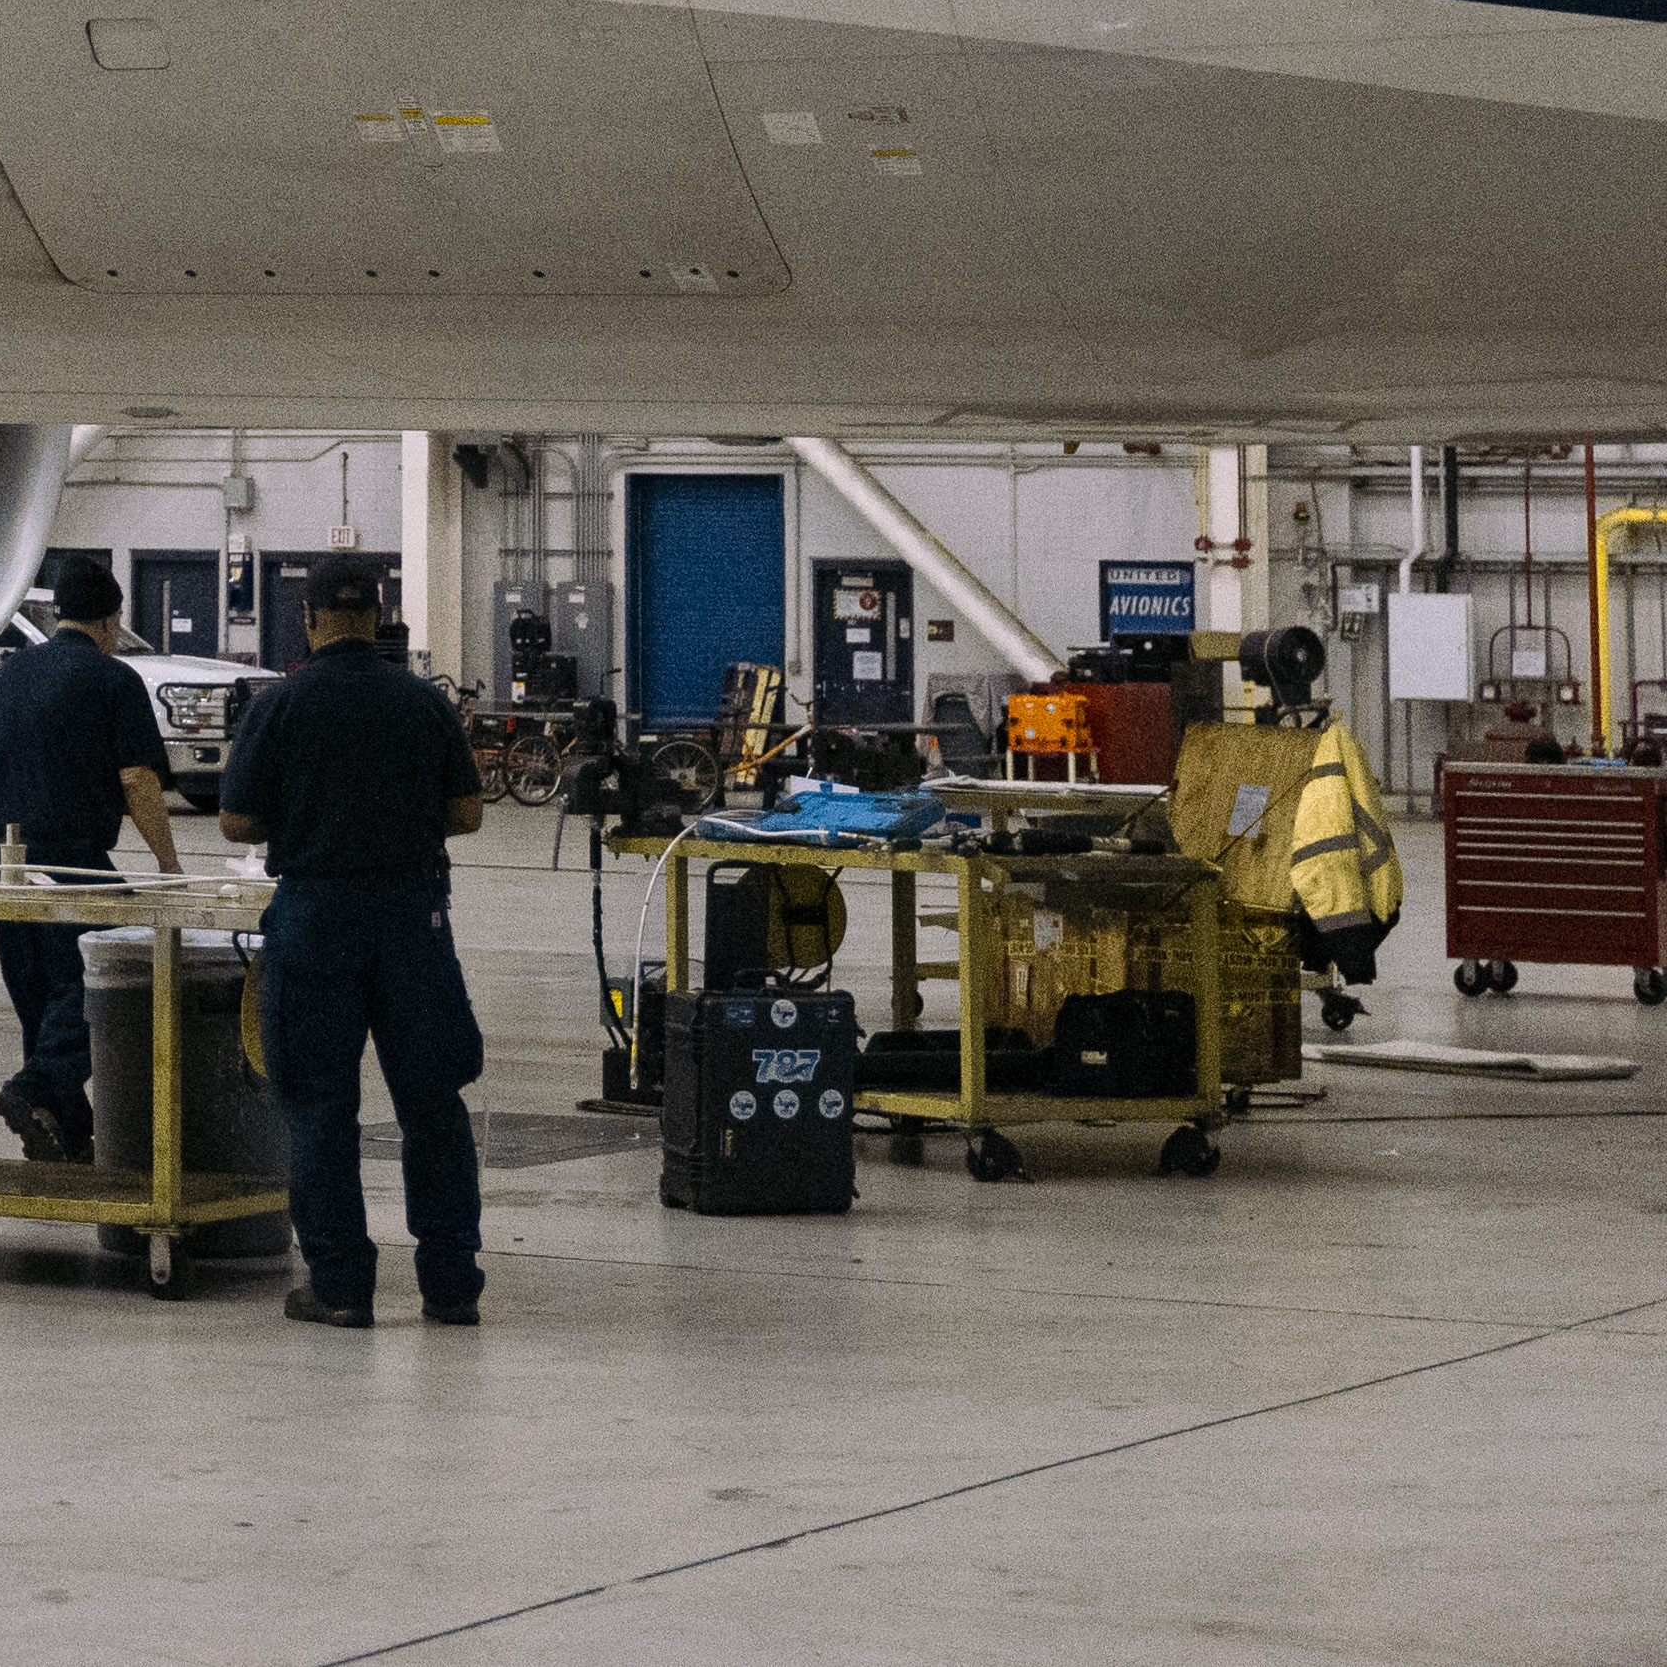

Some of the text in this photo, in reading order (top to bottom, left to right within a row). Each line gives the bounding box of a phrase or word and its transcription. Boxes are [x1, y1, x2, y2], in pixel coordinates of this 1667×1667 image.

[331, 528, 351, 544] EXIT
[1110, 570, 1177, 581] UNITED
[1109, 596, 1191, 617] AVIONICS
[752, 1049, 821, 1083] 787
